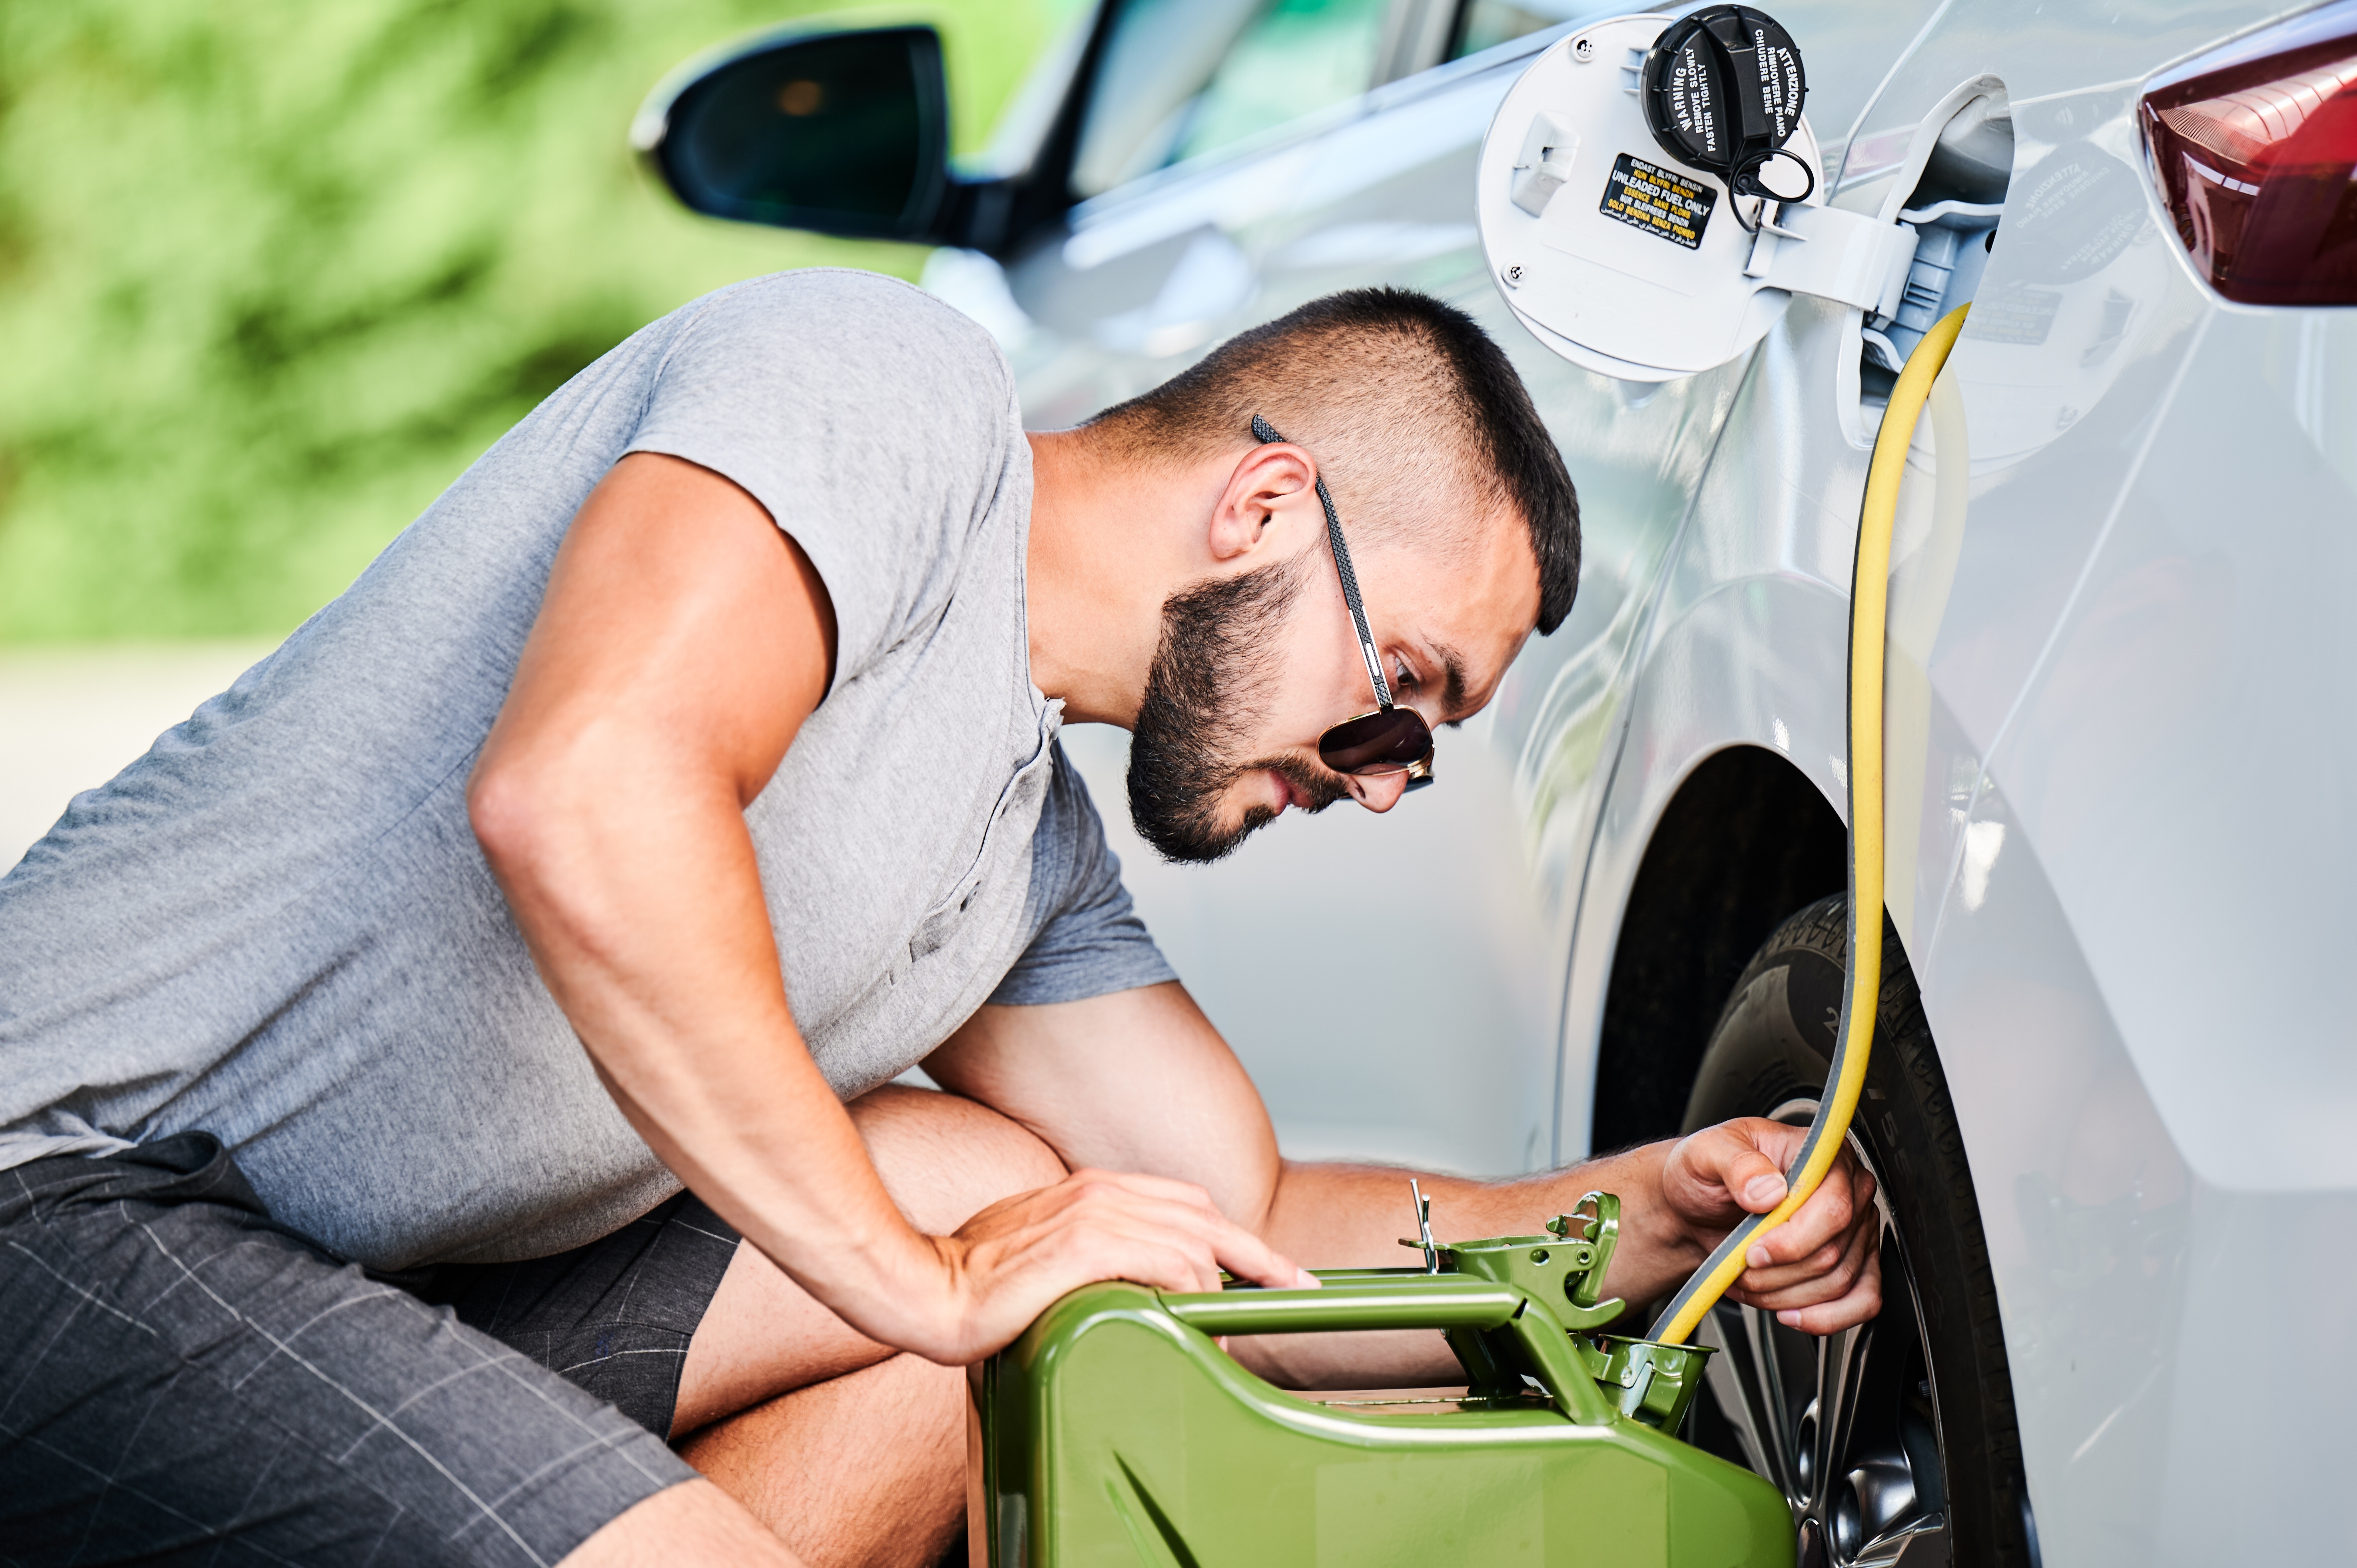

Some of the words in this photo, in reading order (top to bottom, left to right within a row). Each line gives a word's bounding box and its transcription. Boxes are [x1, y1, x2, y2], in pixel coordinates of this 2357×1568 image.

[1685, 48, 1698, 88] SLOWLY
[1697, 64, 1710, 108] TIGHTLY
[1755, 29, 1769, 82] CHIUDERE
[1763, 86, 1773, 114] BENE
[1776, 47, 1799, 117] ATTENZIONE
[1673, 67, 1693, 131] WARNING
[1767, 46, 1782, 105] RIMUOVERE
[1775, 106, 1786, 137] PIANO
[1691, 92, 1704, 133] REMOVE
[1703, 112, 1716, 152] FASTEN
[1612, 169, 1660, 197] UNLEADED
[1661, 189, 1683, 208] FUEL
[1685, 199, 1710, 217] ONLY
[1631, 159, 1656, 174] ENDAST
[1657, 169, 1678, 183] BLYFRI
[1680, 179, 1704, 194] BENSIN
[1633, 169, 1648, 180] KUN
[1649, 175, 1671, 189] BLYFRI
[1672, 184, 1695, 199] BENZIN
[1608, 198, 1625, 211] SOLO
[1625, 205, 1650, 222] BENZINA
[1651, 216, 1671, 230] SENZA
[1672, 224, 1695, 240] PIOMBO
[1619, 194, 1633, 205] NUR
[1634, 200, 1667, 219] BLEIFREIES
[1668, 213, 1689, 228] BENZIN
[1623, 186, 1650, 203] ESSENCE
[1653, 198, 1670, 211] SANS
[1671, 206, 1691, 219] PLOMB
